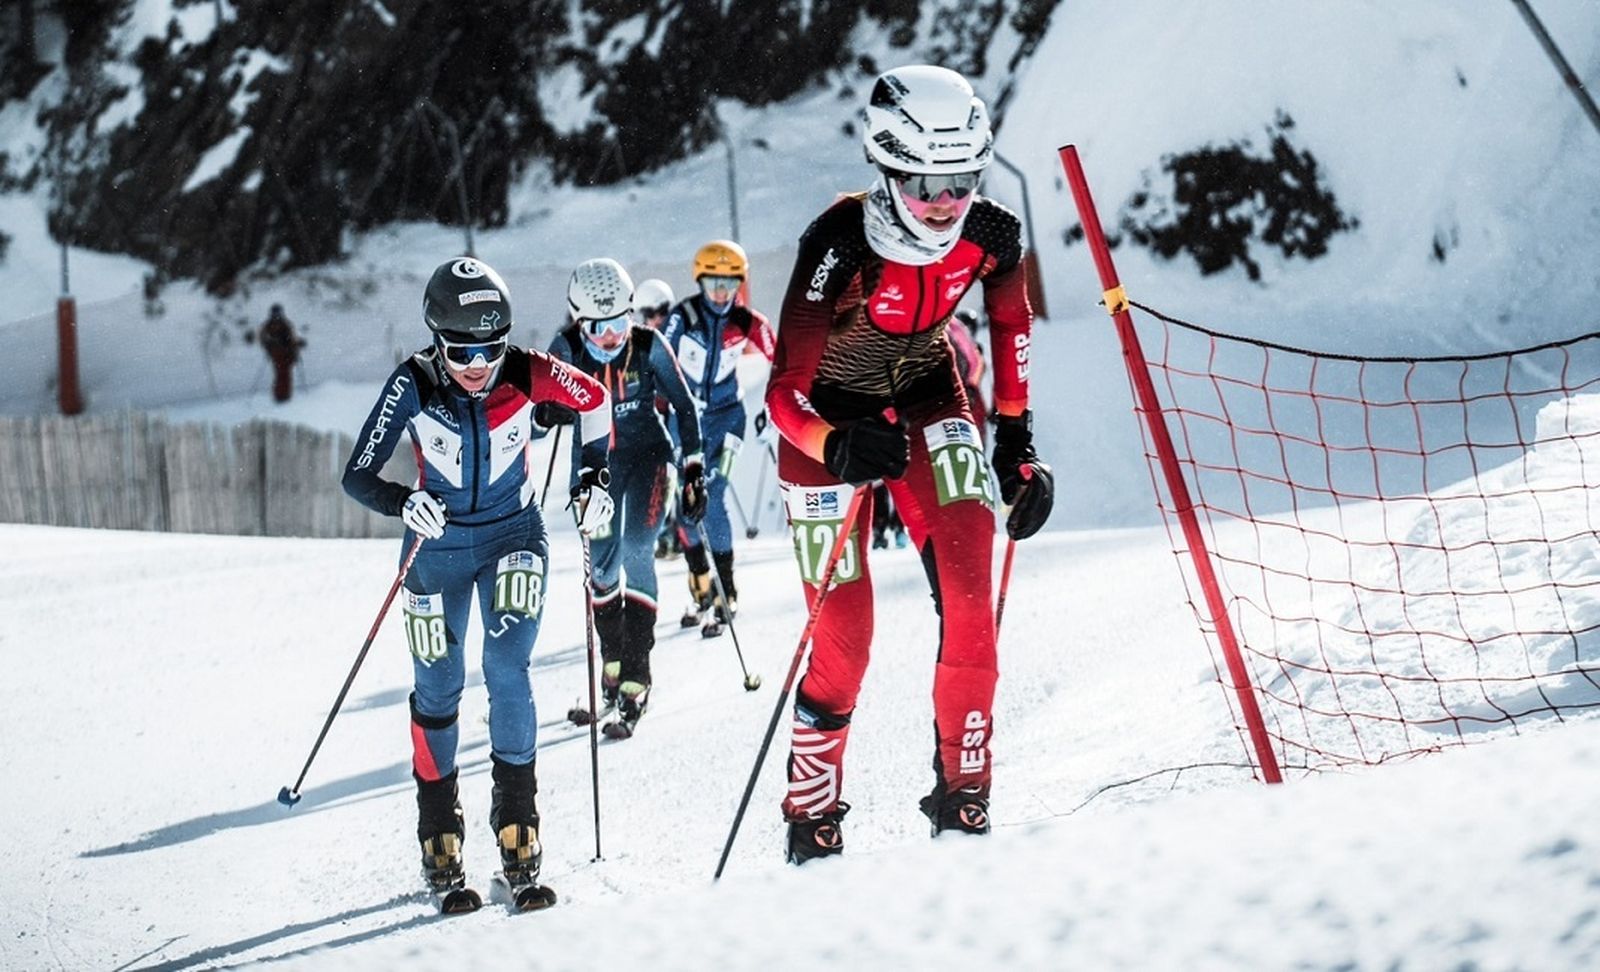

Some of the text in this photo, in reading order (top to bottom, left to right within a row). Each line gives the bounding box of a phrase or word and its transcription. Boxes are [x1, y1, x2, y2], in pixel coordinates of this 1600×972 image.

[1014, 333, 1031, 380] ESP
[550, 363, 593, 405] FRANCE
[354, 375, 410, 471] SPORTIVA
[935, 446, 994, 501] 125
[795, 523, 855, 581] 125
[496, 572, 542, 616] 108
[403, 611, 447, 657] 108
[960, 710, 988, 769] ESP
